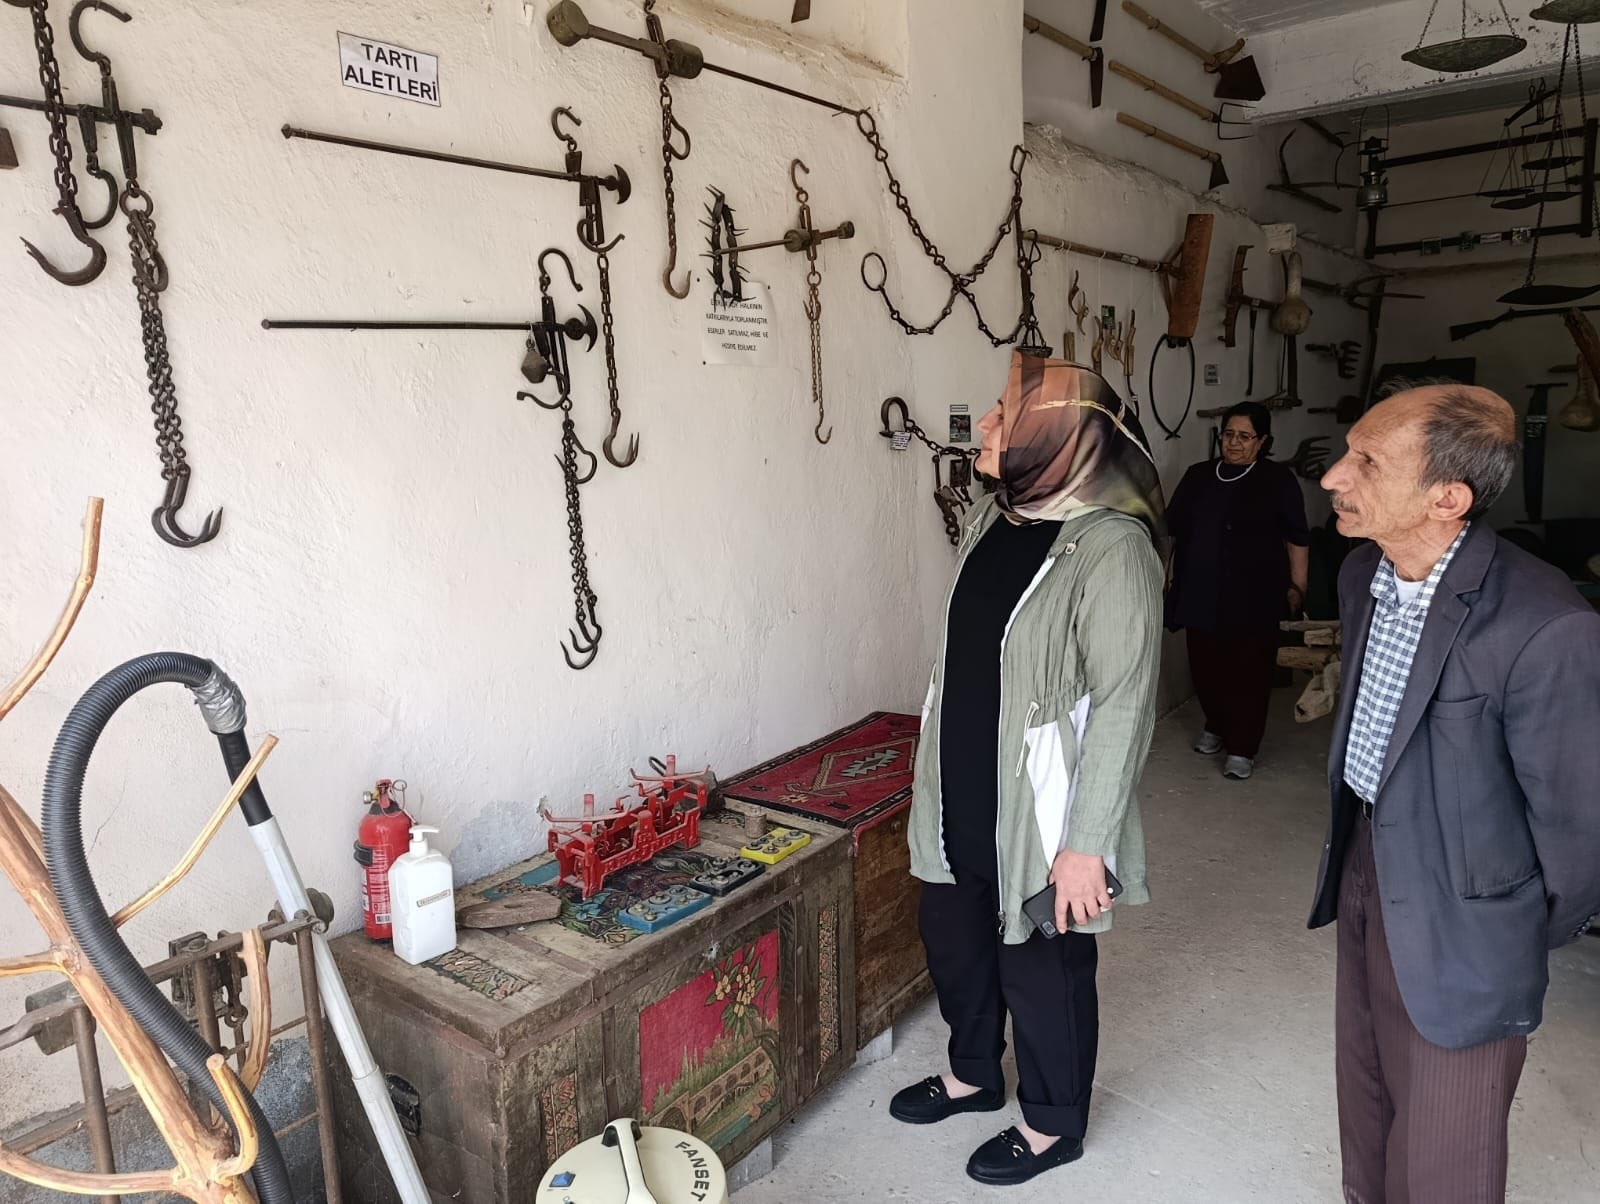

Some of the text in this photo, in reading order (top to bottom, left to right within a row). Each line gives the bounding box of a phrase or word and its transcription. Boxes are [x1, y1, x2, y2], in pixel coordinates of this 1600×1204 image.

[361, 43, 417, 72] TARTI
[344, 64, 437, 101] ALETLERİ
[675, 1141, 710, 1202] FANSET
